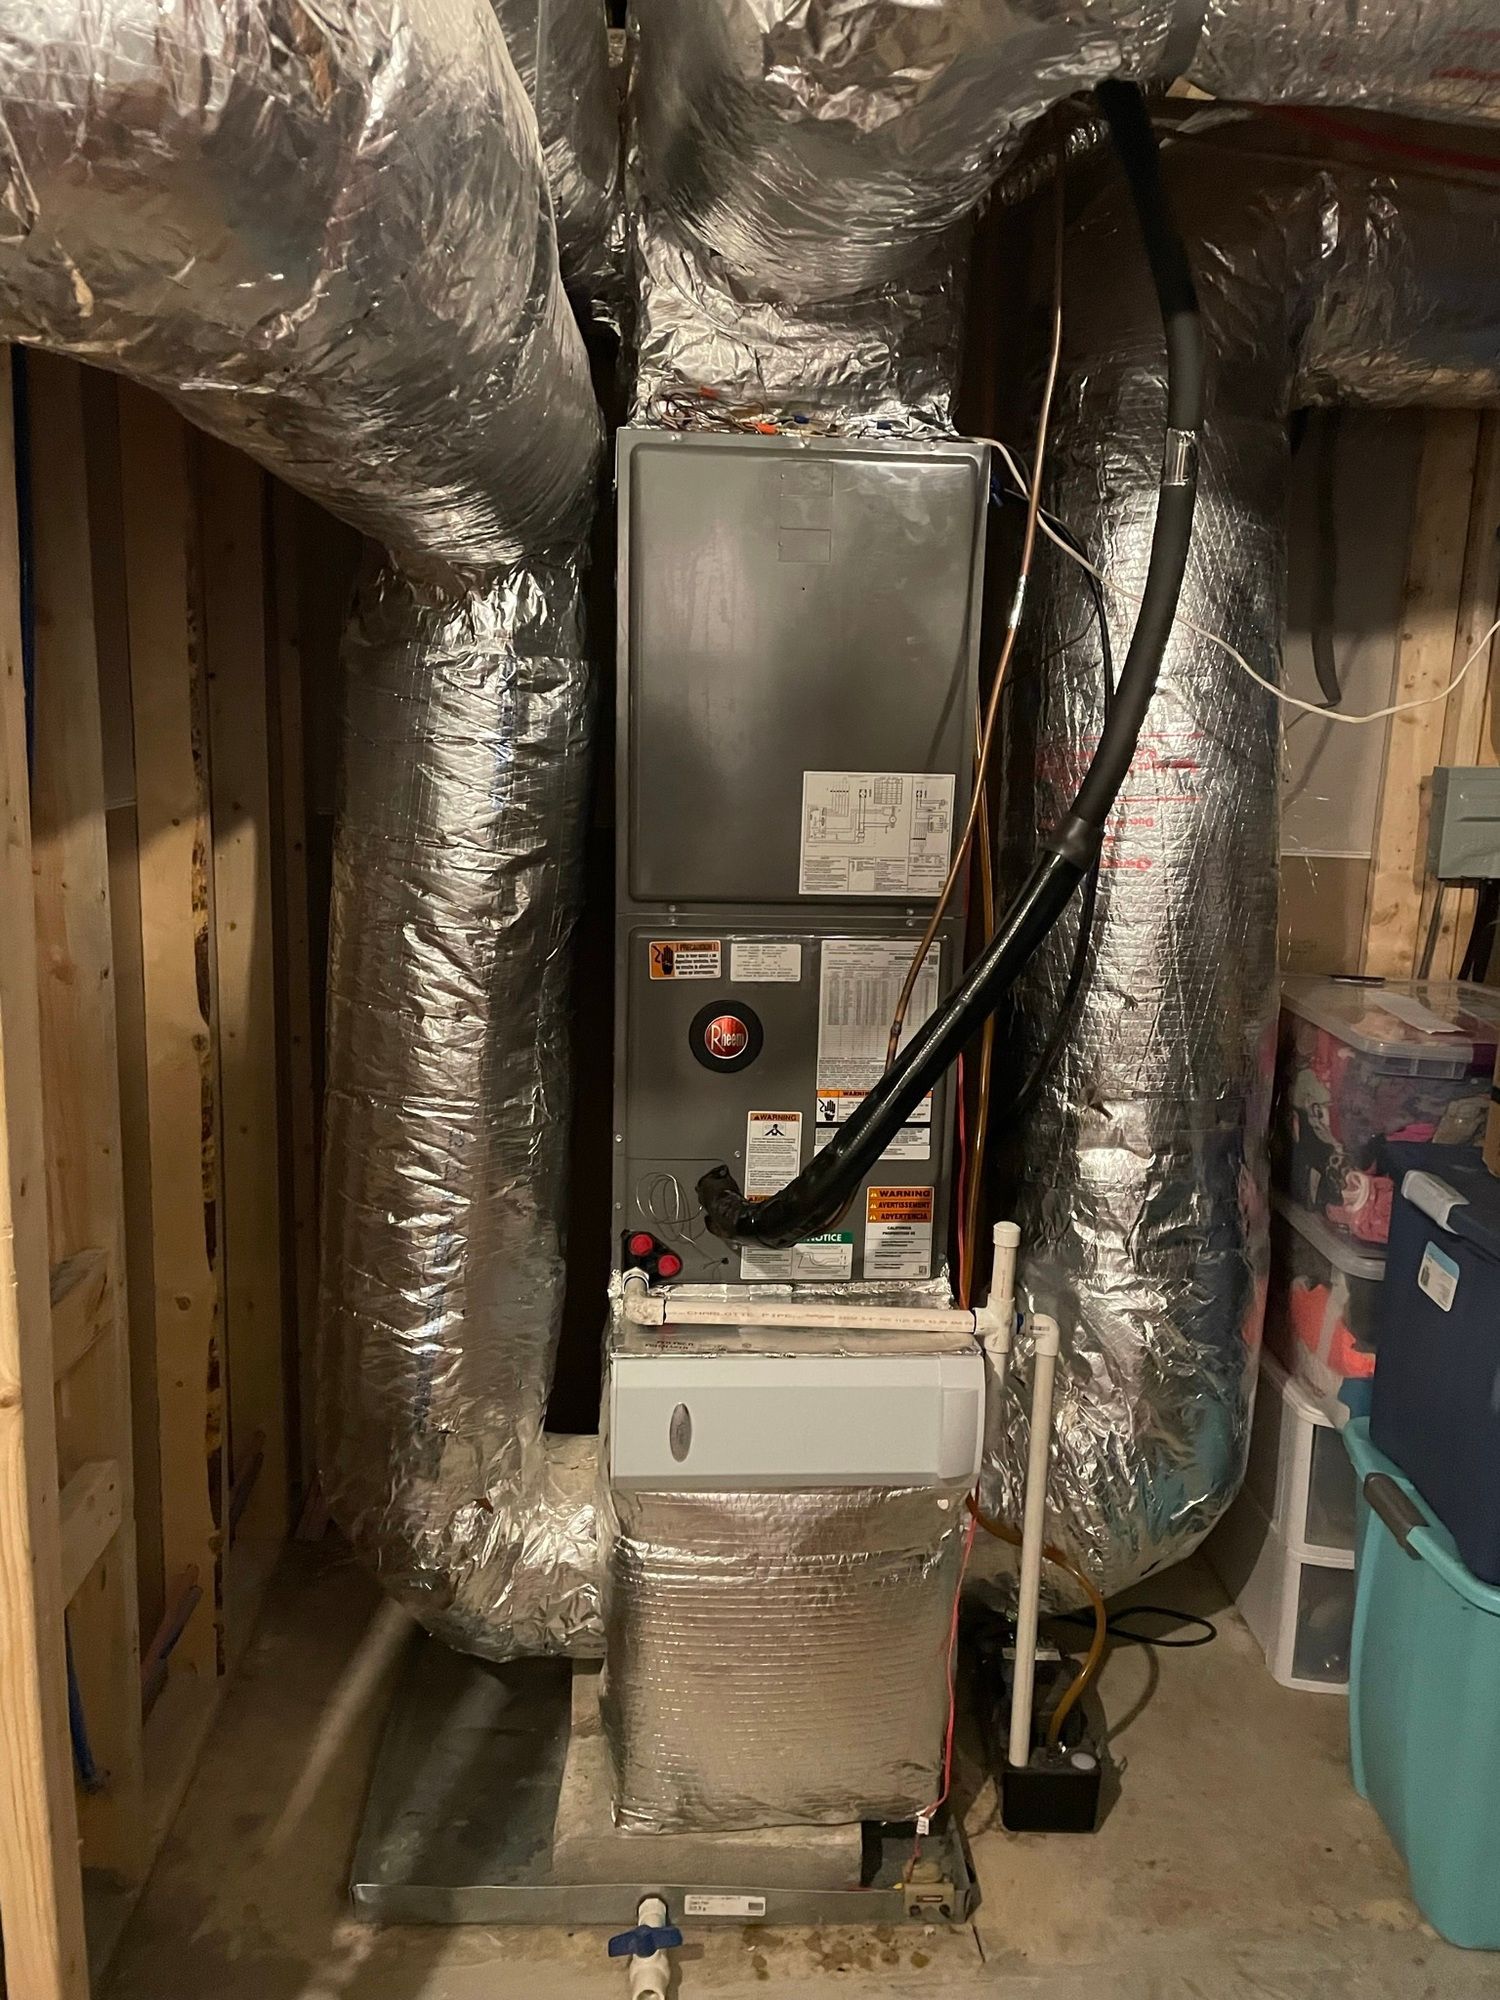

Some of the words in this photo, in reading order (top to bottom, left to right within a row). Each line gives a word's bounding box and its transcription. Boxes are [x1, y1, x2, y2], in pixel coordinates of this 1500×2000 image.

[711, 1024, 745, 1052] Rheem
[879, 1190, 931, 1198] WARNING
[878, 1201, 930, 1209] AVERTISSEMENT
[806, 1233, 842, 1242] OTICE
